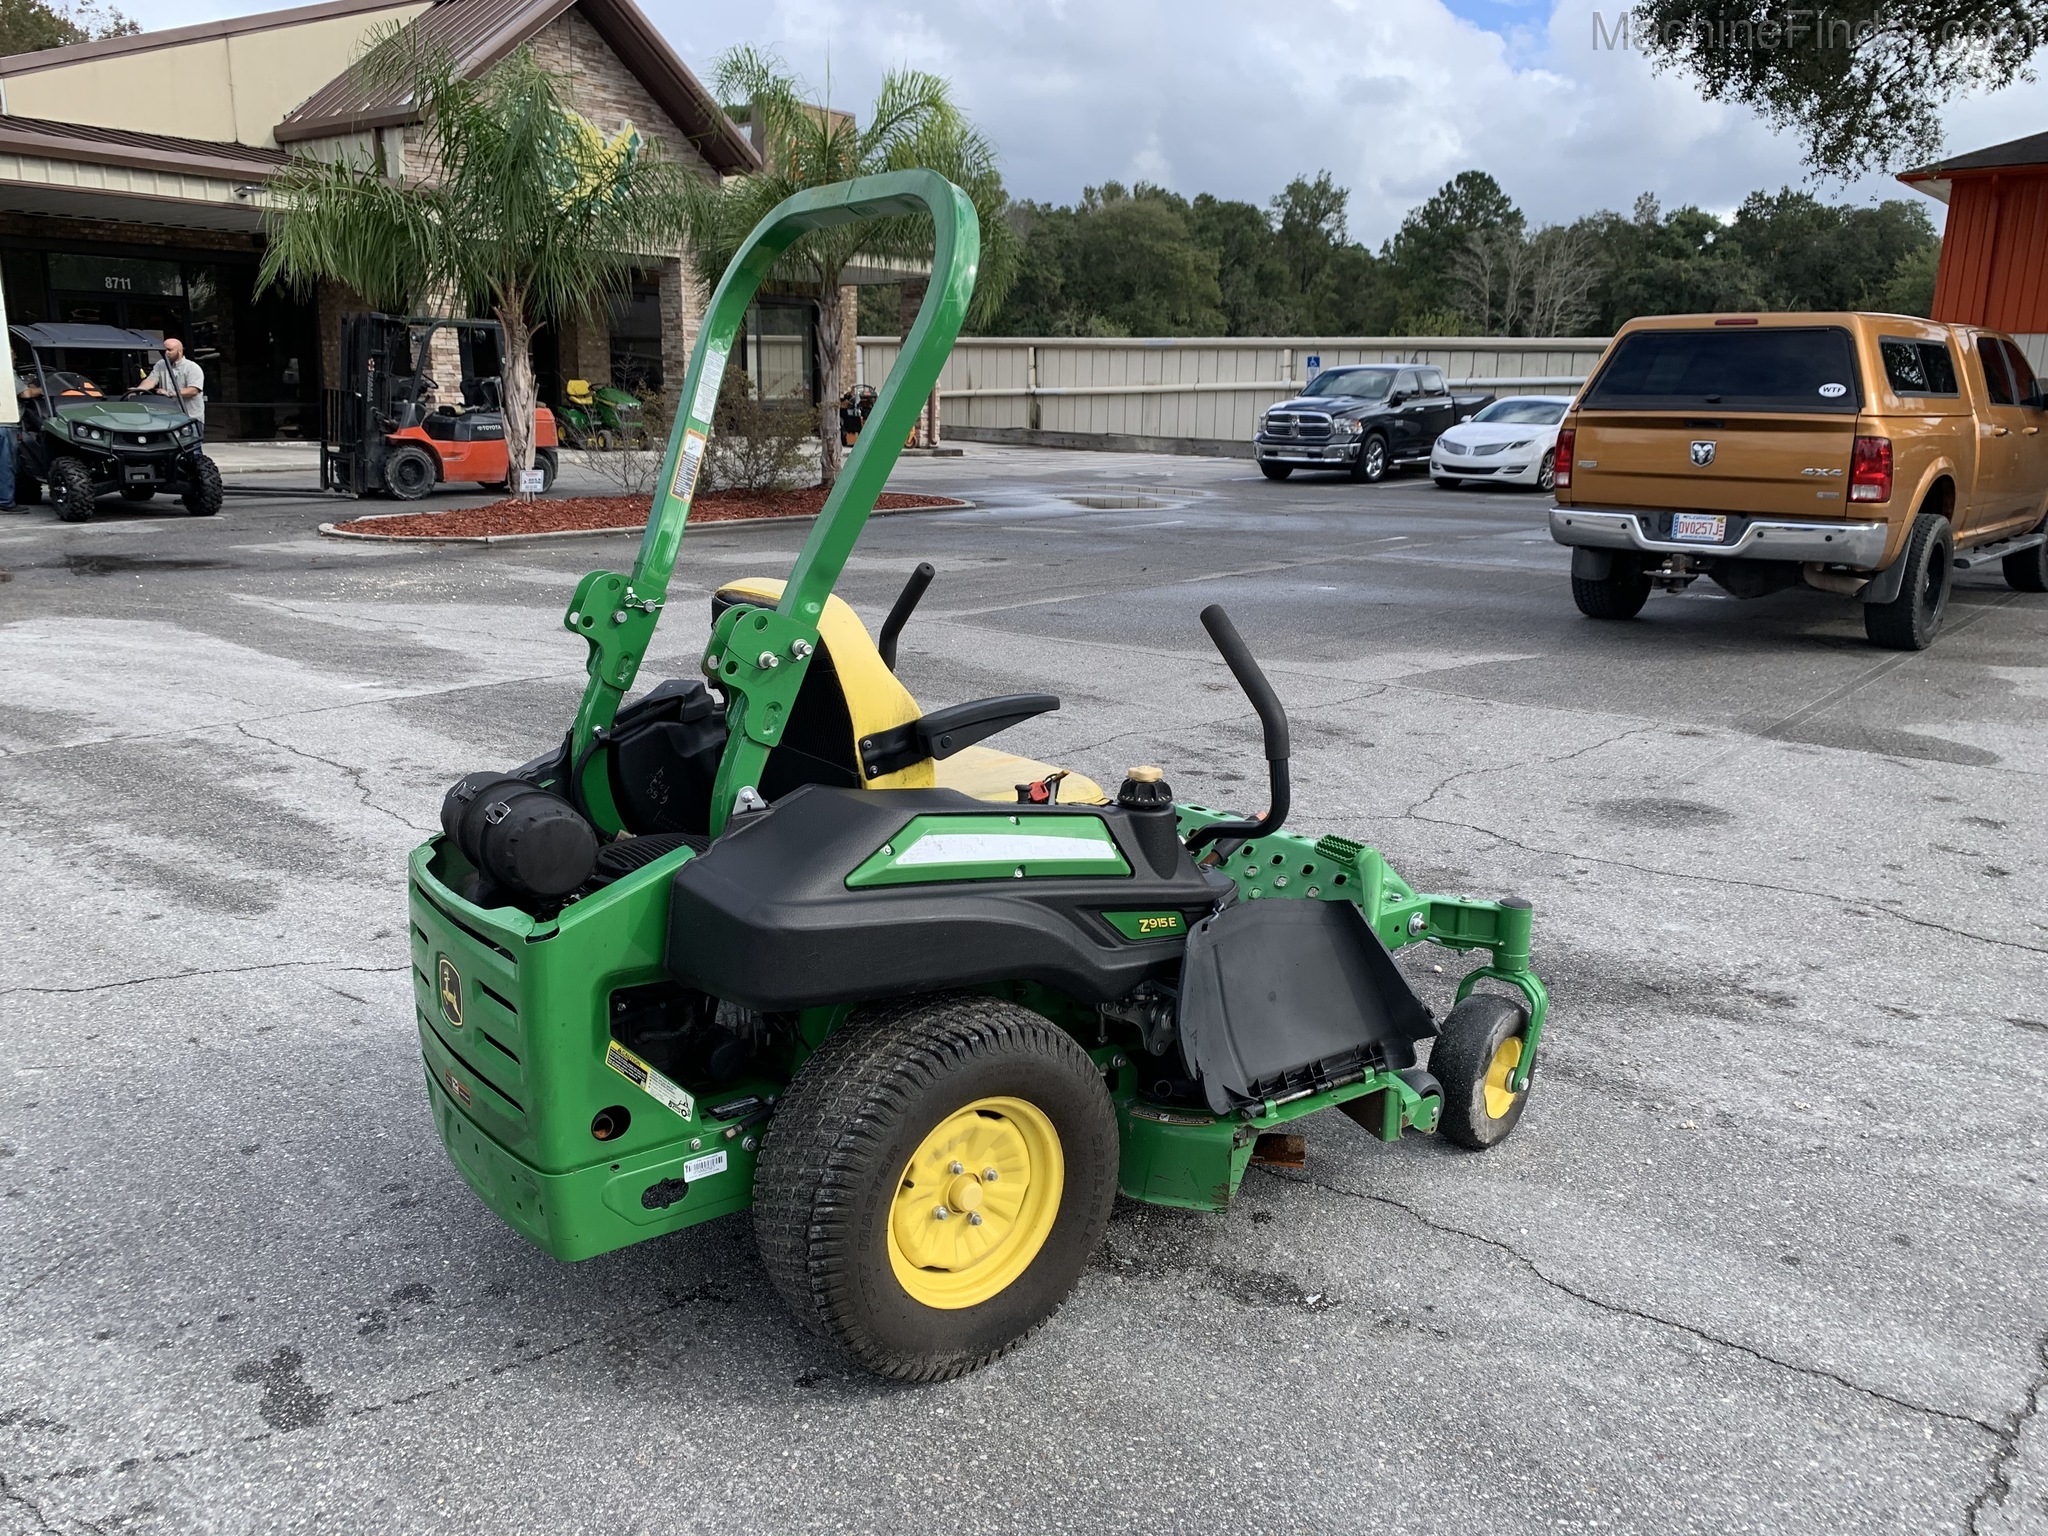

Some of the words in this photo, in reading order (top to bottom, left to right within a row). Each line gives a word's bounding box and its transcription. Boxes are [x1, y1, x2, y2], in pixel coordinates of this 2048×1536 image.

[104, 276, 132, 290] 8711
[1678, 521, 1720, 536] DV0257J
[1139, 917, 1177, 933] Z915E
[858, 1144, 901, 1251] MASTER
